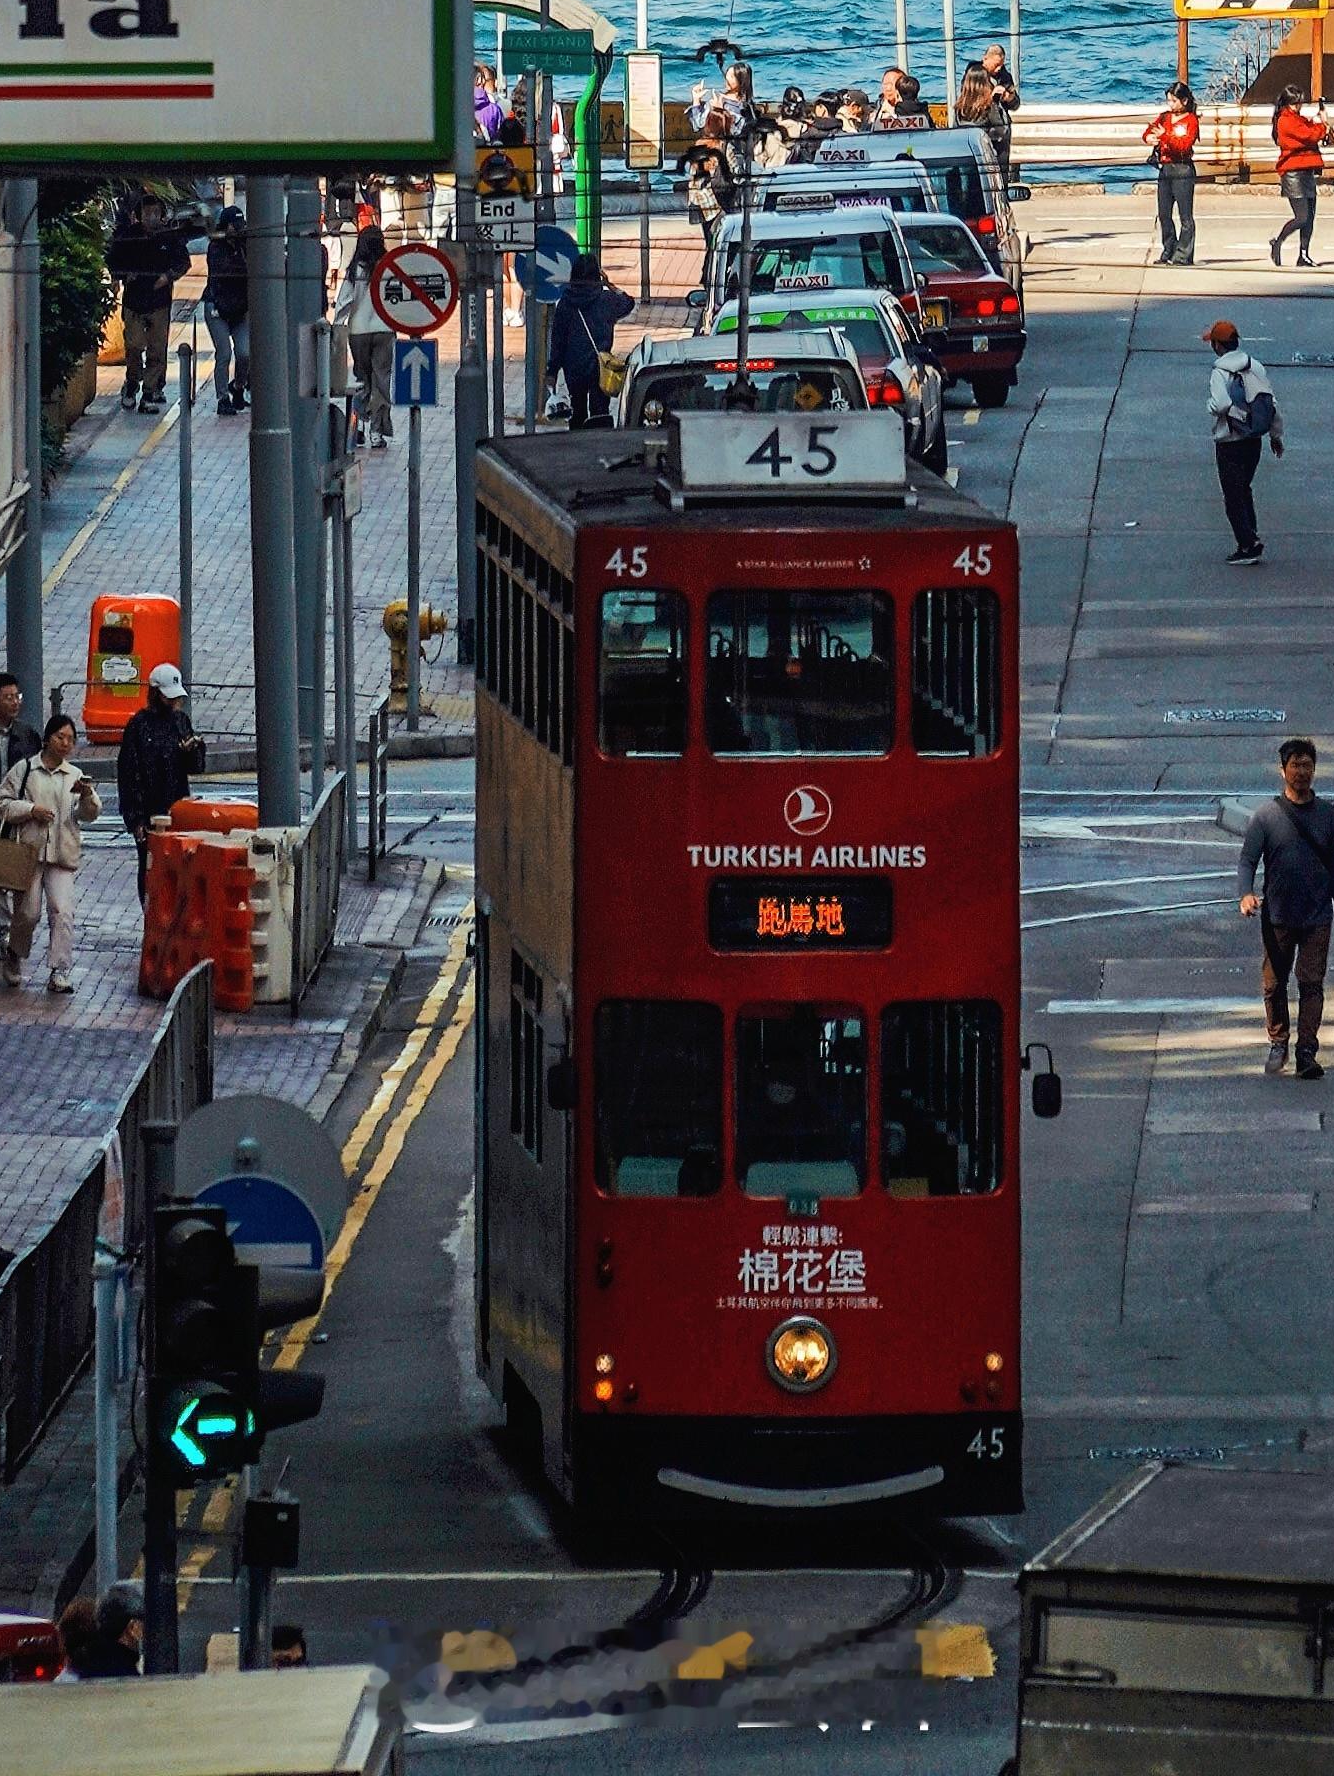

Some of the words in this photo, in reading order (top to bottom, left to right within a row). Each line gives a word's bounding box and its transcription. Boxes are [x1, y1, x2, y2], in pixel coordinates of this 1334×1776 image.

[508, 37, 539, 48] TAXI
[542, 37, 586, 48] STAND
[879, 117, 924, 129] TAXI
[819, 150, 865, 161] TAXI
[481, 202, 515, 217] End
[840, 197, 888, 208] TAXI
[779, 276, 829, 288] TAXI
[745, 426, 839, 478] 45
[606, 547, 649, 578] 45
[953, 545, 993, 576] 45
[687, 845, 804, 869] TURKISH
[810, 844, 927, 869] AIRLINES
[757, 896, 846, 938] 跑馬地
[738, 1248, 867, 1294] 棉花堡
[967, 1427, 1005, 1459] 45
